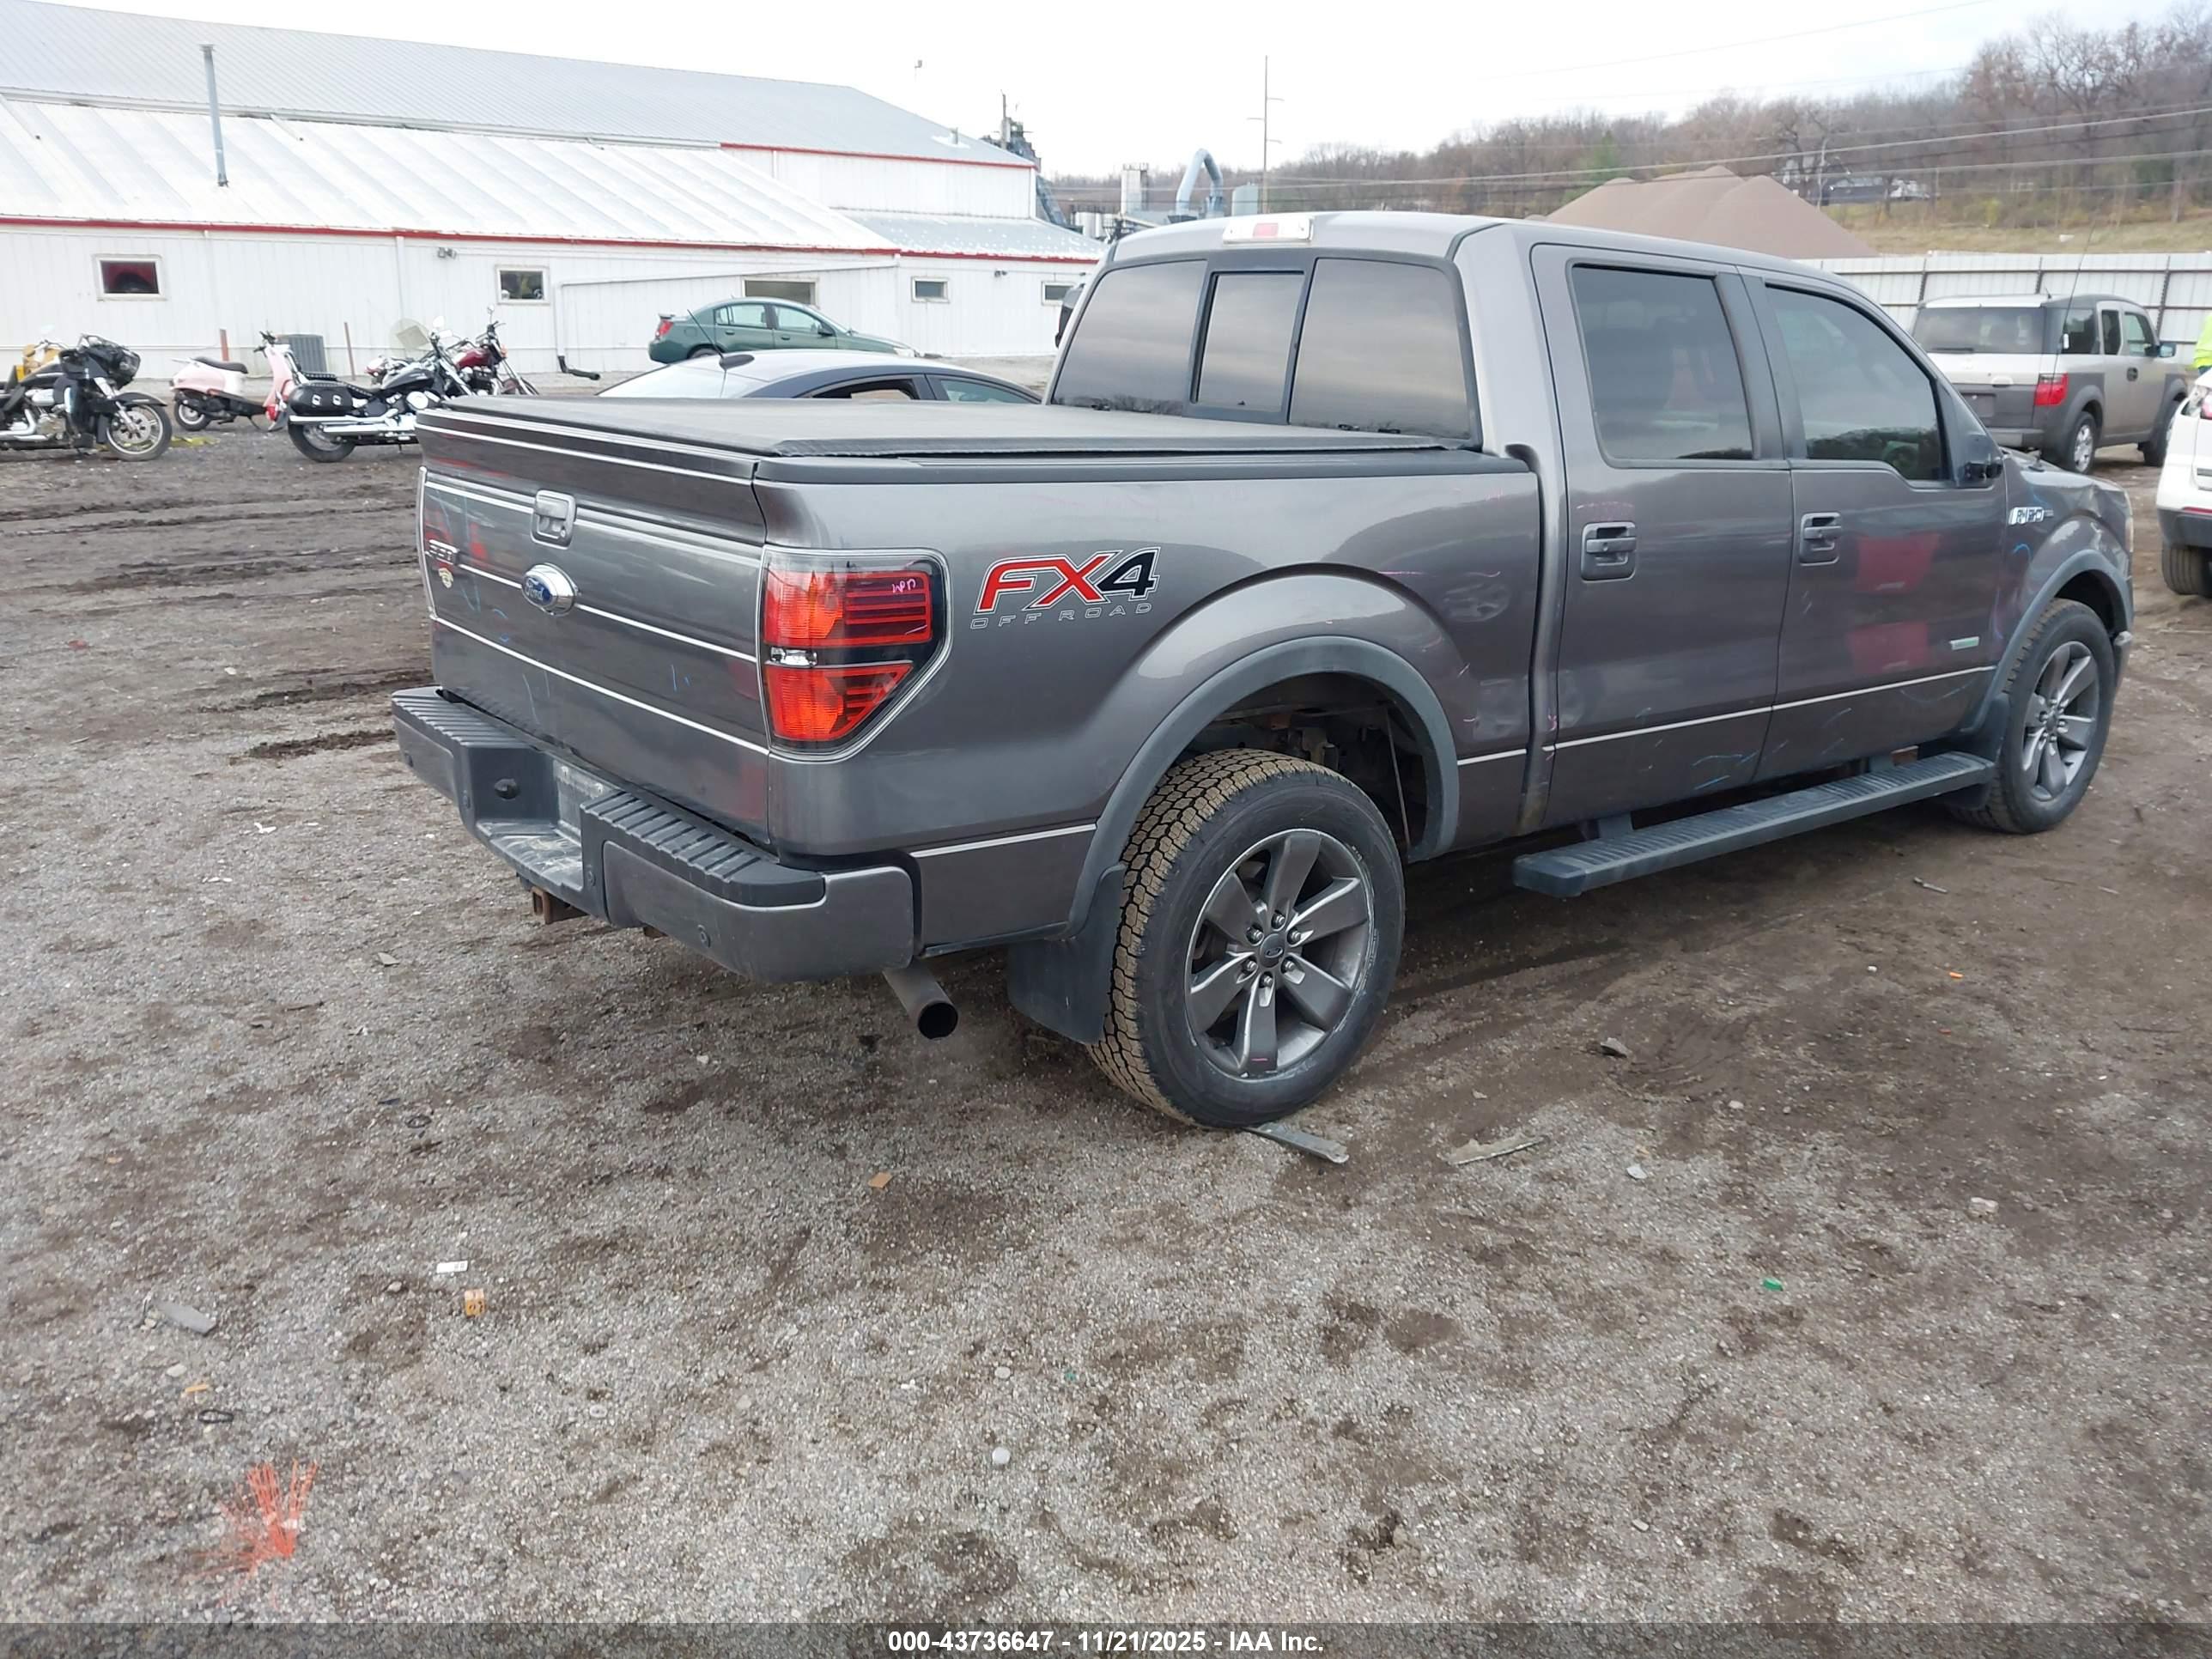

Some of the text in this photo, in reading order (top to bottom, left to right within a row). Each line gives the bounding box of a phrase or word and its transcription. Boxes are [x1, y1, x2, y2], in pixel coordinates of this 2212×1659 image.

[526, 577, 544, 601] Ford
[974, 546, 1161, 616] FX4
[970, 603, 1152, 629] OFF ROAD
